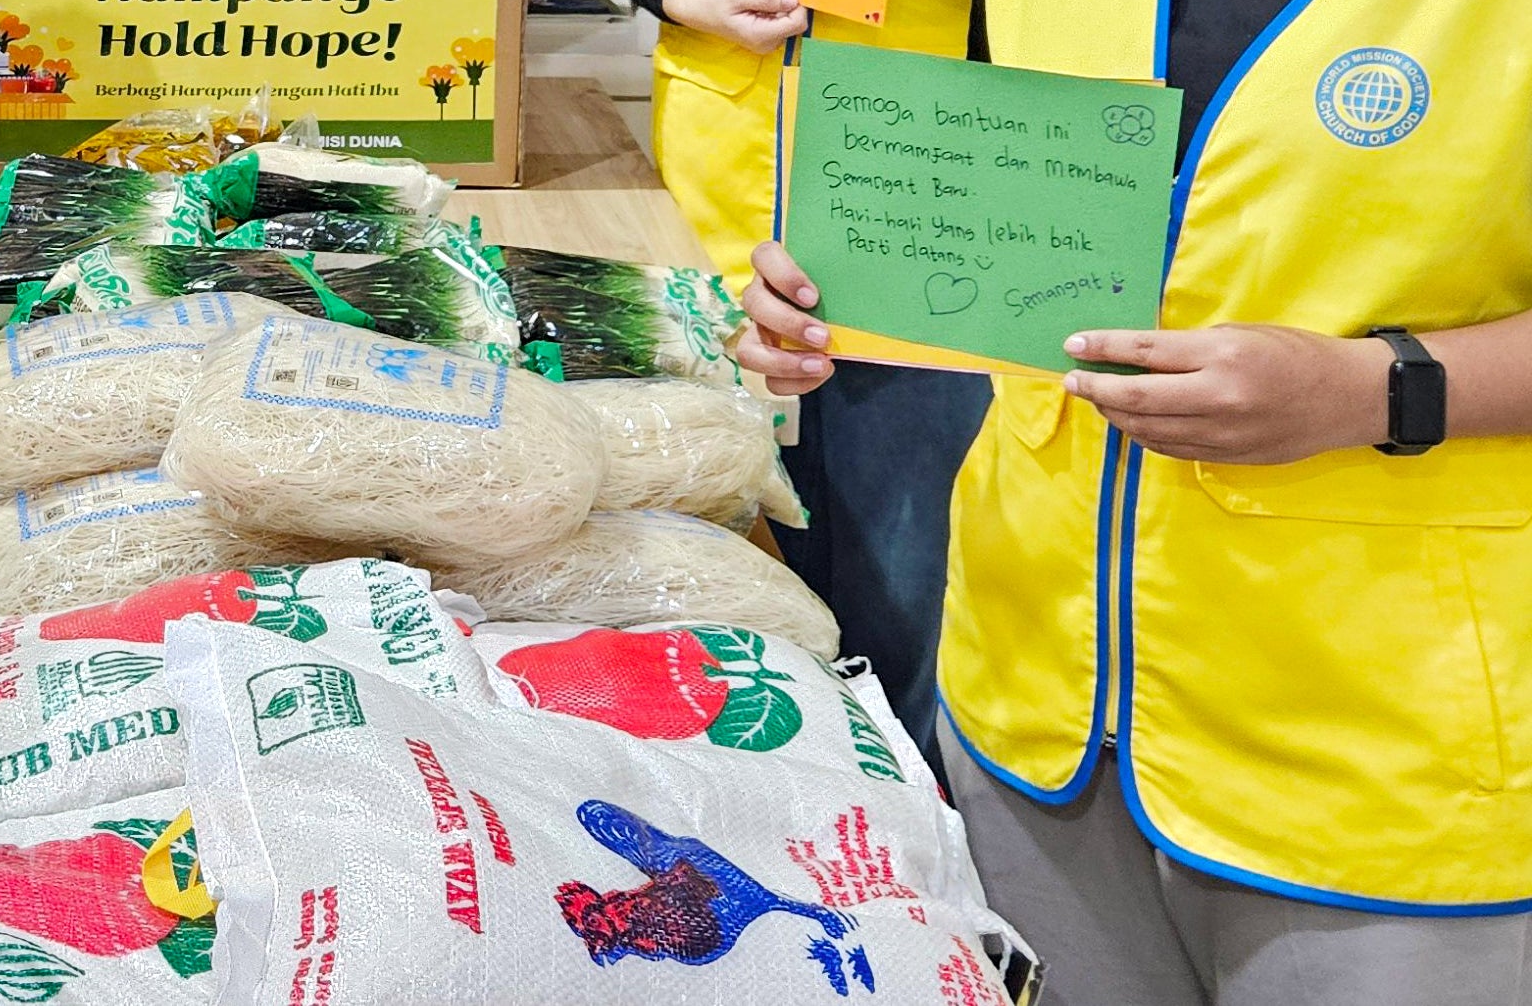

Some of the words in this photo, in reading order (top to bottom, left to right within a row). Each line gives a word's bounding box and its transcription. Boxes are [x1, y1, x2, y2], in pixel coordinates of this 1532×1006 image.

[99, 21, 230, 60] Hold
[240, 21, 403, 69] Hope!
[95, 83, 167, 101] Berbagi
[171, 84, 251, 100] Harapan
[328, 83, 365, 96] Hati
[369, 83, 400, 96] Ibu
[1320, 59, 1351, 94] WORLD
[1351, 51, 1403, 65] MISSION
[1402, 61, 1426, 107] SOCIETY
[821, 82, 915, 127] Semoga
[934, 101, 1029, 134] bantuan
[1318, 100, 1365, 144] CHURCH
[1369, 131, 1389, 145] OF
[1392, 113, 1421, 137] GOD
[349, 136, 403, 148] DUNIA
[994, 146, 1030, 169] dan
[822, 160, 917, 195] Semangat
[1050, 226, 1094, 253] baik
[1003, 276, 1104, 318] Semangat
[68, 706, 180, 763] MED
[404, 737, 469, 834] SPECIAL
[442, 838, 484, 935] AYAM
